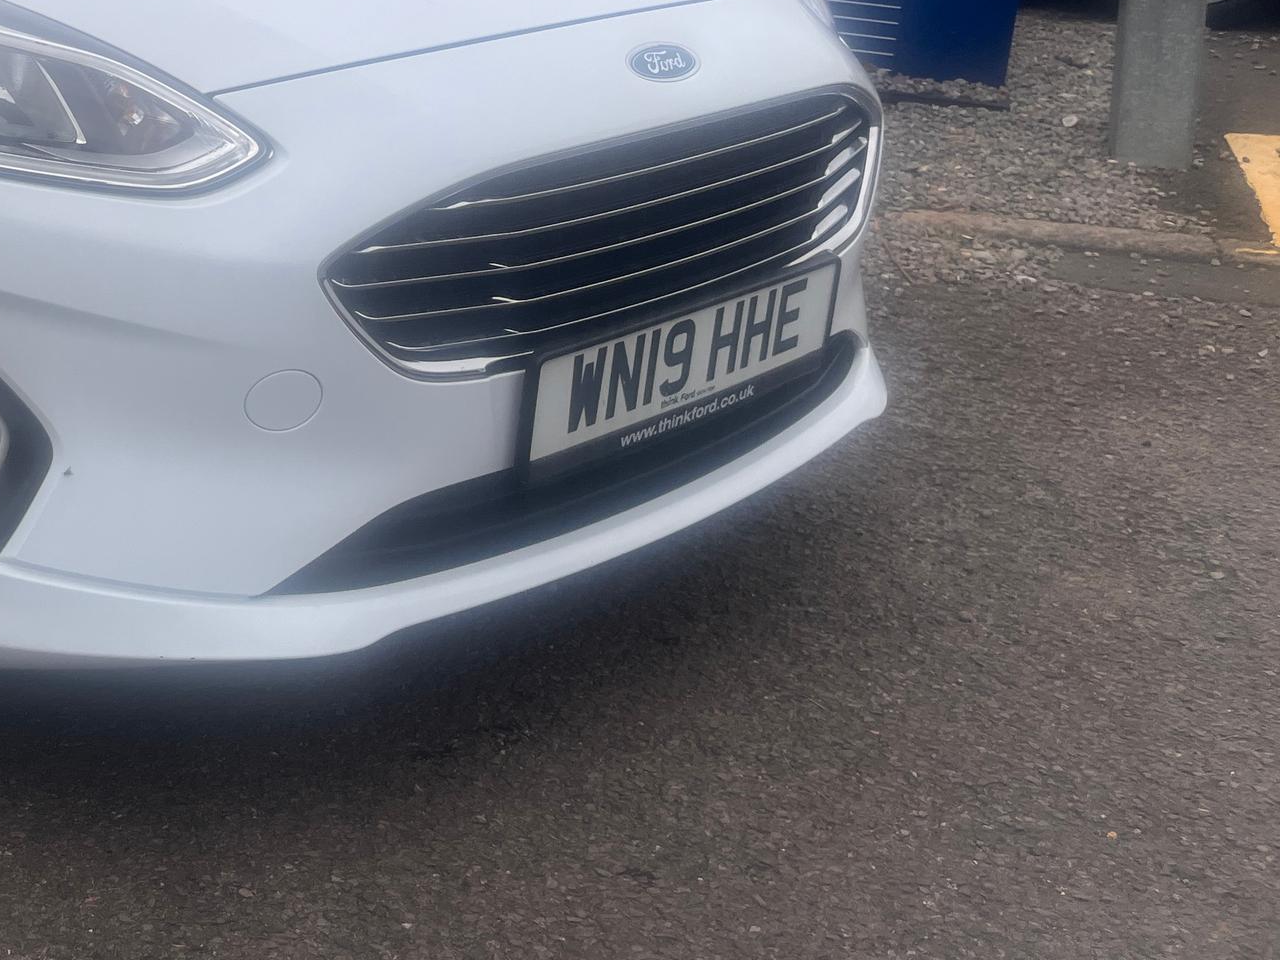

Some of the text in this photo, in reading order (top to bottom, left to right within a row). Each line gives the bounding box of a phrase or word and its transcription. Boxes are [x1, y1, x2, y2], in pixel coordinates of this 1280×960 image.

[643, 50, 687, 74] Ford
[567, 277, 809, 434] WN19 HHE
[620, 383, 755, 448] www.thinkford.co.uk
